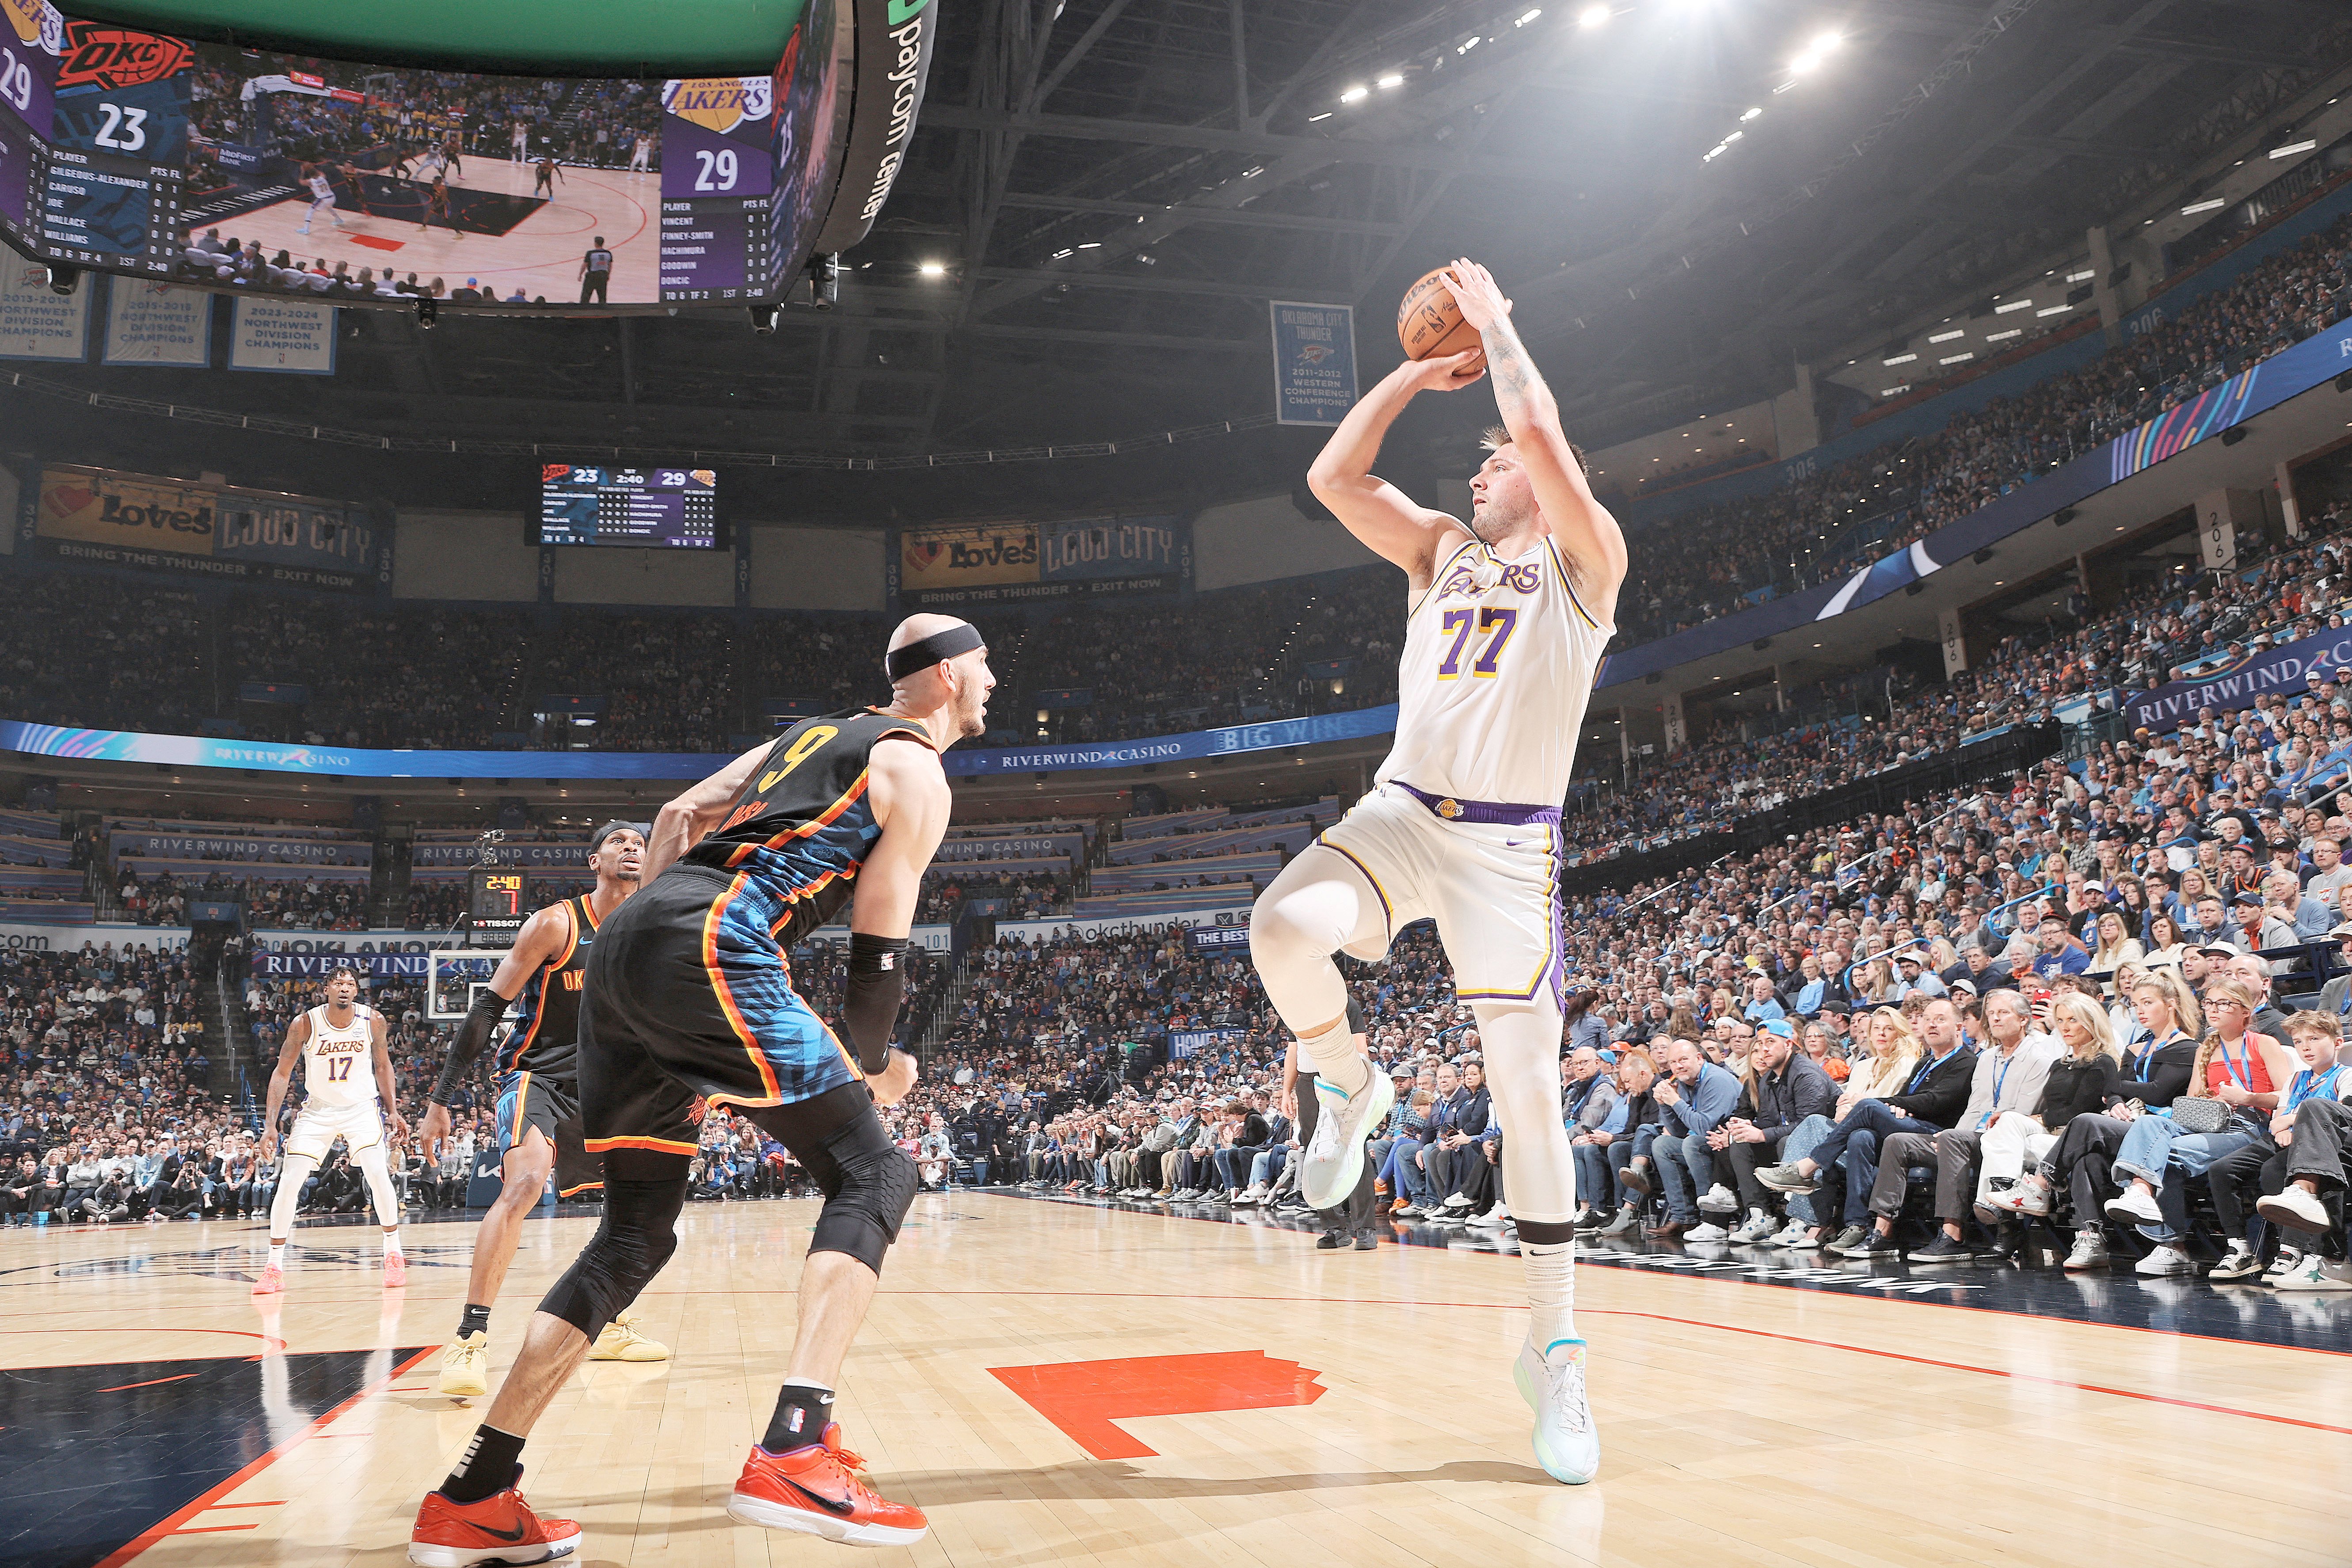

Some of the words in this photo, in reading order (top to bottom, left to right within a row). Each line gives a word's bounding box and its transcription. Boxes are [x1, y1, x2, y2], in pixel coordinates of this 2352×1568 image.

[68, 42, 159, 73] OKC
[0, 46, 32, 110] 29
[888, 17, 922, 145] paycom
[662, 83, 767, 115] LAKERS
[95, 103, 148, 151] 23
[53, 150, 88, 164] PLAYER
[150, 166, 168, 177] PTS
[170, 168, 181, 179] FL
[694, 148, 738, 191] 29
[49, 165, 149, 190] GILGEOUS-ALEXANDER
[155, 183, 163, 192] 6
[172, 185, 177, 194] 1
[860, 150, 902, 221] center
[49, 182, 86, 196] CARUSO
[154, 198, 161, 207] 0
[169, 200, 177, 209] 0
[46, 198, 65, 209] JOE
[152, 214, 160, 223] 3
[168, 216, 175, 225] 0
[663, 202, 692, 211] PLAYER
[743, 199, 758, 209] PTS
[759, 199, 769, 208] FL
[46, 213, 87, 228] WALLACE
[151, 229, 159, 239] 0
[167, 231, 174, 240] 0
[662, 217, 694, 226] VINCENT
[761, 213, 766, 222] 1
[44, 229, 88, 244] WILLIAMS
[150, 245, 158, 254] 0
[165, 247, 173, 256] 0
[662, 231, 714, 240] FINNEY-SMITH
[748, 229, 754, 238] 3
[761, 228, 766, 237] 1
[760, 243, 767, 251] 0
[49, 247, 62, 257] TO
[66, 249, 74, 259] 6
[79, 251, 91, 261] TF
[94, 254, 102, 263] 4
[119, 256, 136, 266] 1ST
[147, 261, 168, 273] 2:40
[661, 261, 697, 270] GOODWIN
[760, 258, 767, 266] 0
[760, 273, 767, 282] 0
[3, 293, 71, 304] 2013-2014
[665, 291, 677, 301] TO
[679, 291, 685, 300] 6
[690, 290, 700, 300] TF
[703, 290, 709, 299] 2
[723, 288, 737, 298] 1ST
[746, 288, 764, 297] 2:40
[0, 305, 76, 316] ORTHWEST
[120, 312, 198, 323] NORTHWEST
[251, 307, 318, 319] 2023-2024
[1282, 310, 1324, 326] OKLAHOMA
[1326, 312, 1343, 327] CITY
[5, 316, 64, 327] DIVISION
[130, 323, 186, 333] DIVISION
[245, 318, 323, 331] NORTHWEST
[120, 333, 194, 344] CHAMPIONS
[255, 329, 311, 340] DIVISION
[1297, 326, 1332, 342] THUNDER
[245, 340, 320, 350] CHAMPIONS
[1292, 369, 1341, 378] 2011-2012
[1293, 378, 1341, 388] WESTERN
[1285, 388, 1351, 398] CONFERENCE
[1289, 397, 1348, 407] CHAMPIONS
[574, 468, 598, 483] 23
[616, 474, 645, 484] 2:40
[662, 472, 686, 486] 29
[2210, 512, 2223, 558] 206
[1119, 524, 1172, 565] CITY
[59, 544, 116, 560] BRING
[124, 551, 157, 566] THE
[164, 556, 247, 575] THUNDER
[274, 568, 311, 583] EXIT
[316, 574, 354, 588] NOW
[921, 590, 965, 604] BRING
[969, 588, 997, 600] THE
[1001, 585, 1068, 598] THUNDER
[1092, 581, 1124, 593] EXIT
[1128, 578, 1161, 590] NOW
[1438, 606, 1519, 681] 77
[2138, 658, 2302, 725] RIVERWIND
[757, 725, 839, 794] 9
[1002, 752, 1102, 768] RIVERWIND
[1117, 743, 1181, 761] CASINO
[150, 838, 259, 854] RIVERWIND
[268, 844, 338, 857] CASINO
[993, 840, 1052, 852] CASINO
[486, 875, 521, 890] 2:40
[499, 889, 518, 915] 7
[925, 934, 948, 948] 101
[1196, 931, 1219, 944] THE
[1223, 929, 1249, 942] BEST
[265, 955, 431, 973] RIVERWIND
[315, 1040, 364, 1055] LAKERS
[328, 1057, 353, 1083] 17
